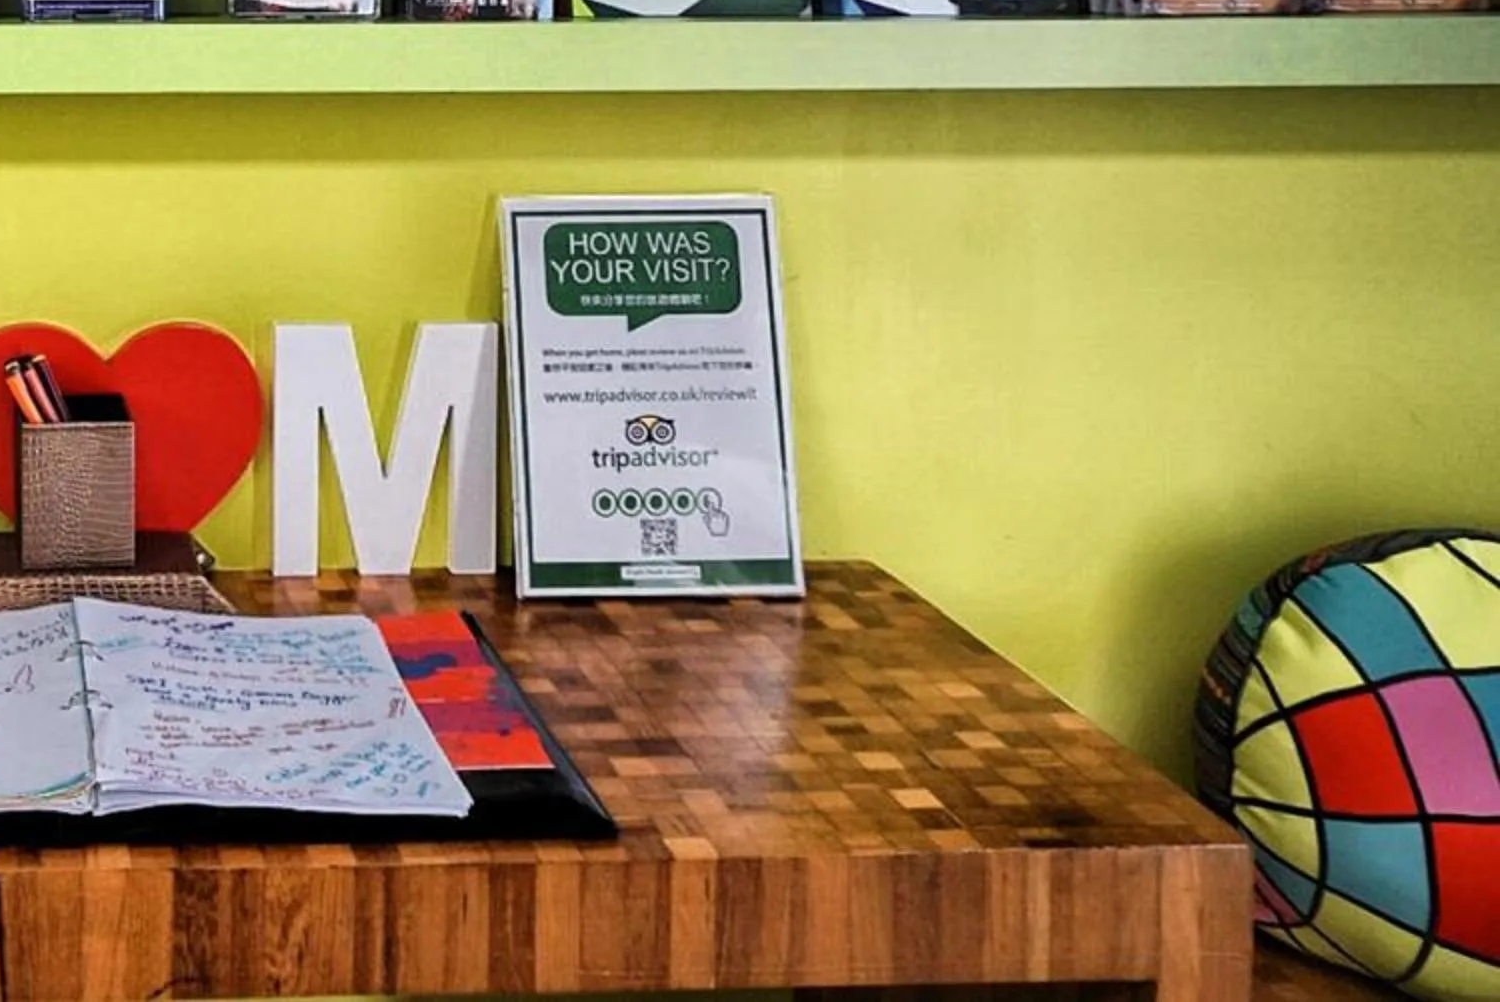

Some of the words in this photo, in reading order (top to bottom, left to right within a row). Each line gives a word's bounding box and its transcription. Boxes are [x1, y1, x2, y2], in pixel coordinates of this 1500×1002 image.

[569, 232, 638, 255] HOW
[644, 231, 711, 255] WAS
[551, 260, 636, 284] YOUR
[643, 258, 731, 283] VISIT?
[592, 447, 712, 473] tripadvisor
